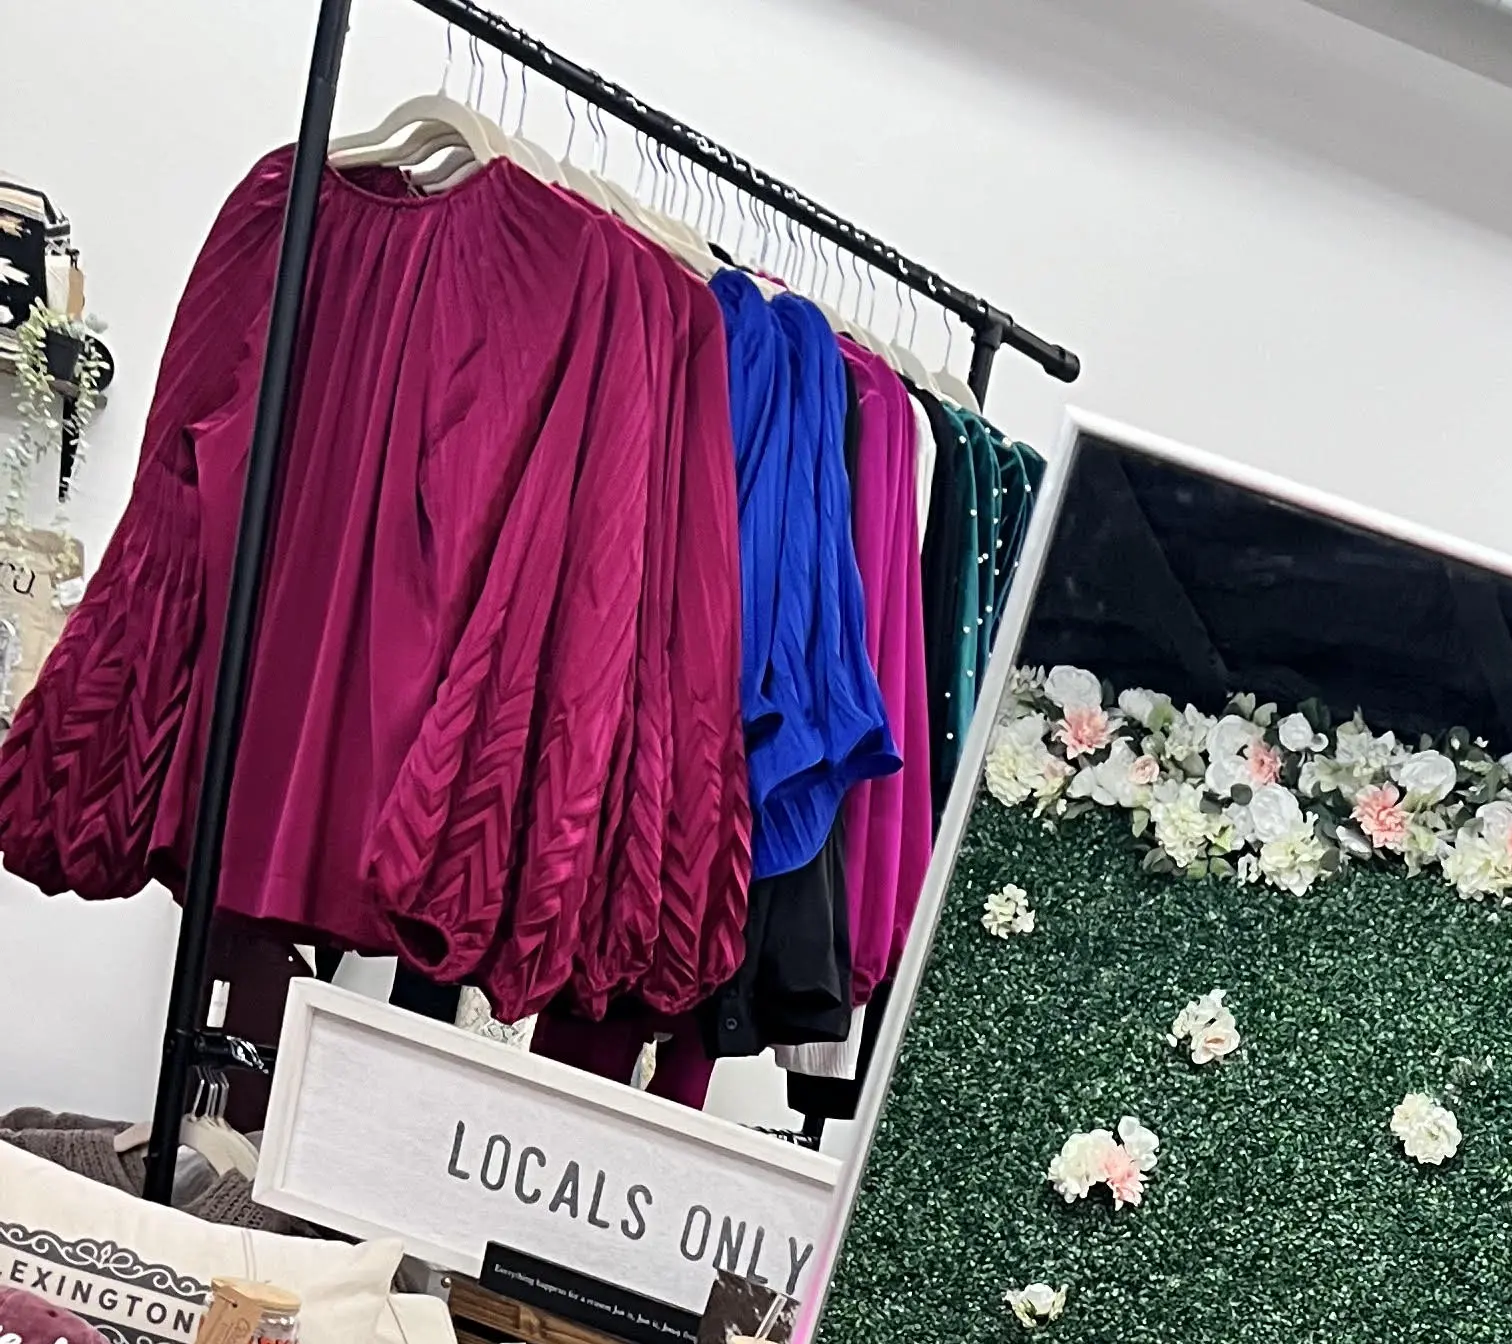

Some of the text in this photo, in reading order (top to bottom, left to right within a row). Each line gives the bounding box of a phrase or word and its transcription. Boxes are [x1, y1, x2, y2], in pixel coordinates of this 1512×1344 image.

[447, 1120, 813, 1296] LOCALS ONLY
[0, 1259, 195, 1334] EXINGTON
